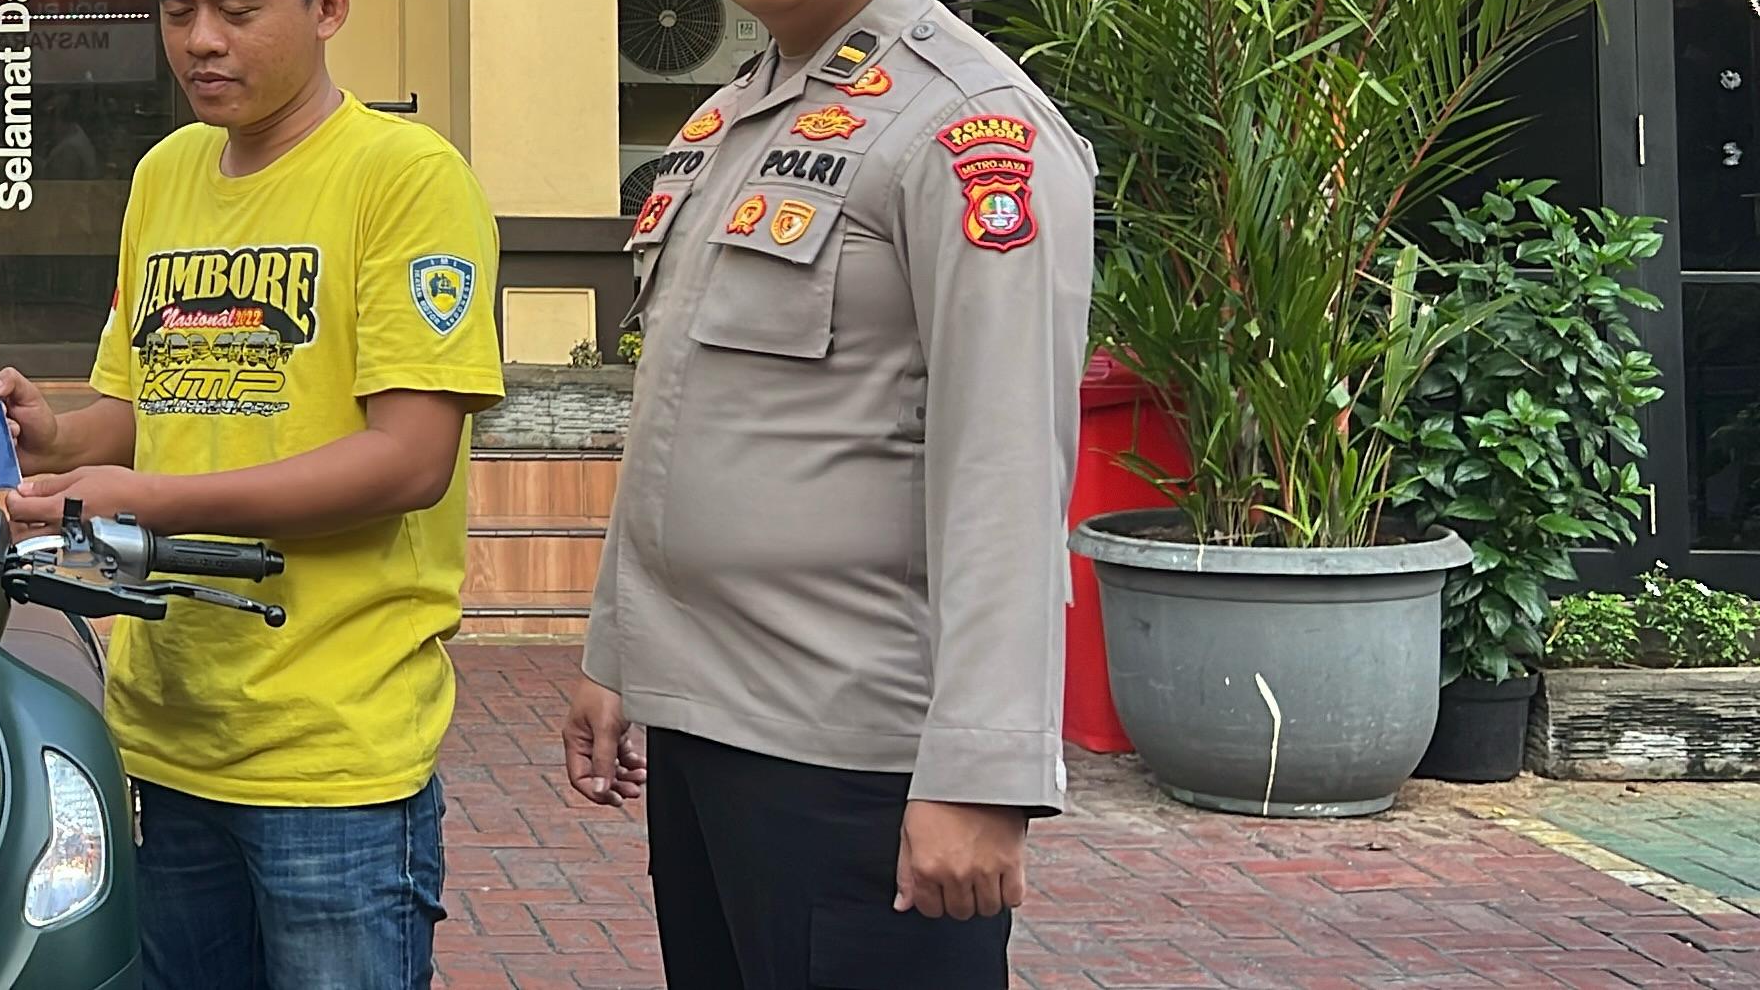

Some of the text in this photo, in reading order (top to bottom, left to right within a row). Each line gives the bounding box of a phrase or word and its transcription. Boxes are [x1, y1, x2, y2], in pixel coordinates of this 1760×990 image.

[951, 119, 1024, 140] POLSEK
[952, 128, 1026, 146] TAMBORA
[760, 150, 847, 186] POLRI
[962, 160, 1026, 174] METRO JAYA
[131, 251, 314, 339] JAMBORE
